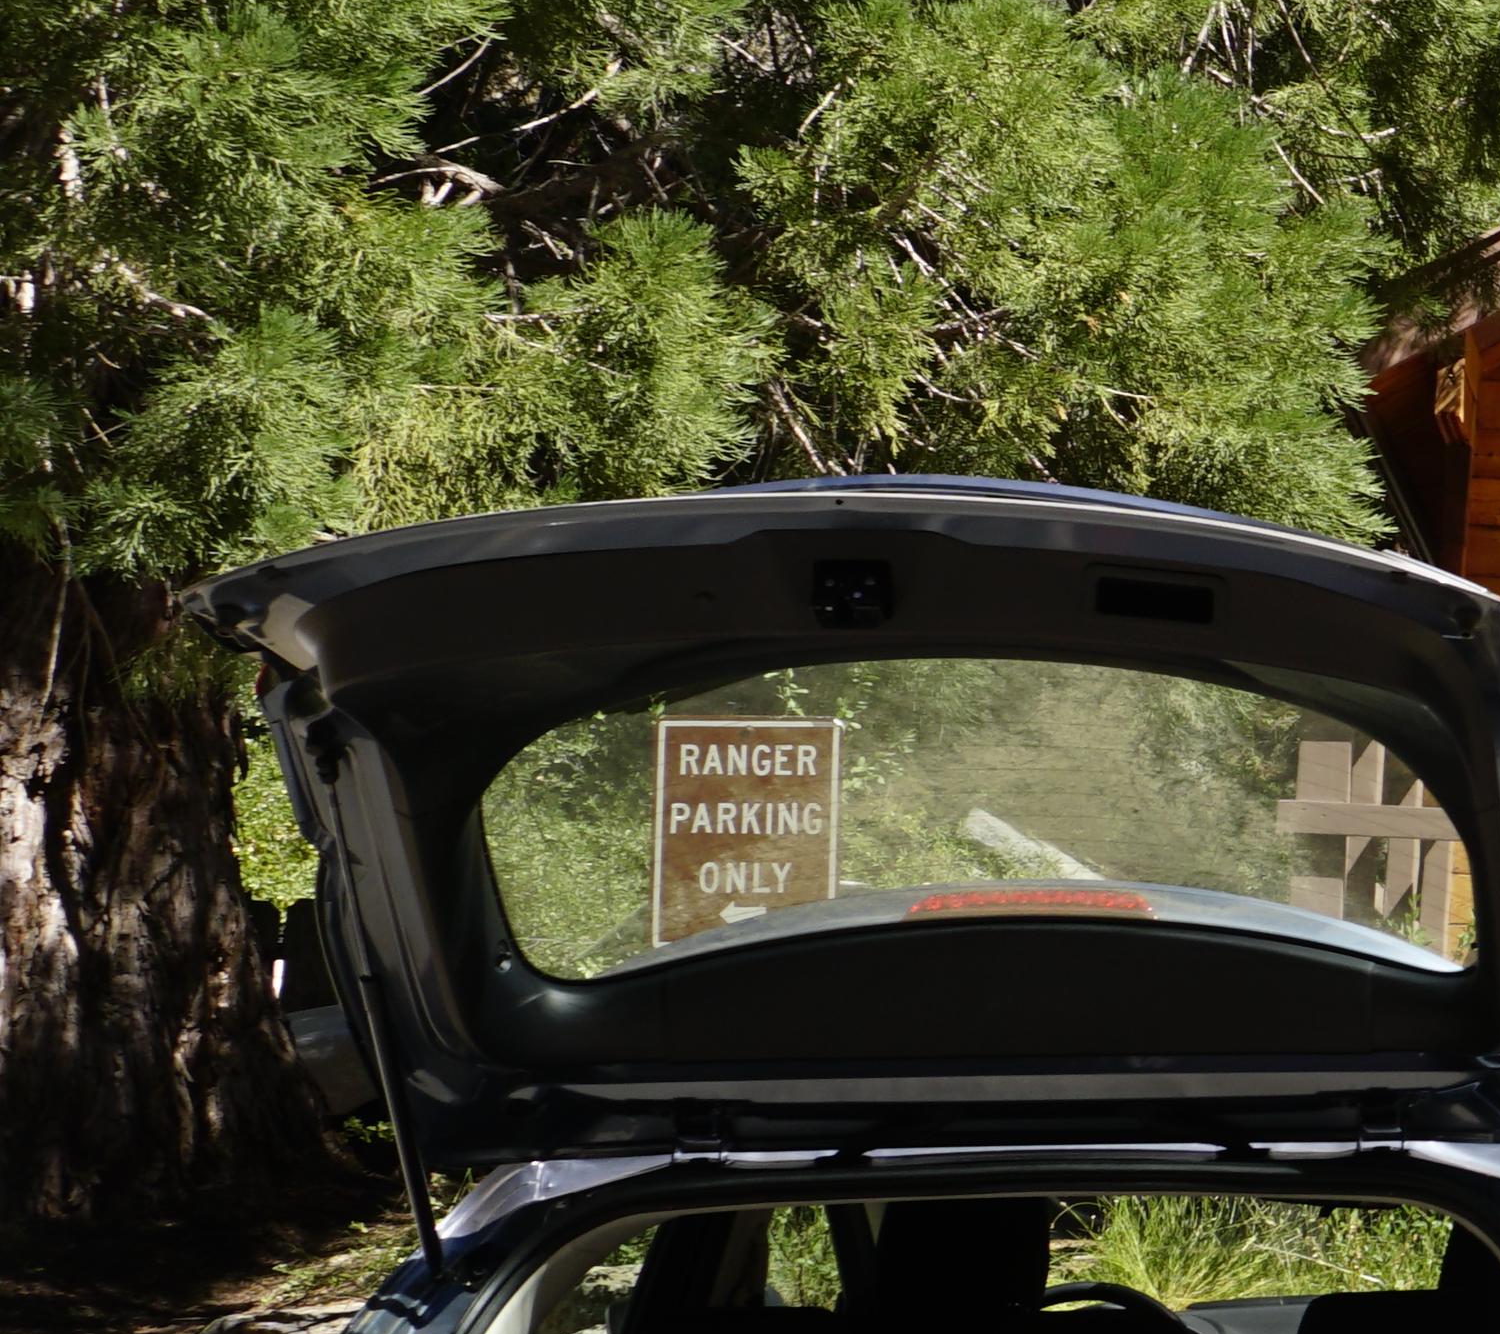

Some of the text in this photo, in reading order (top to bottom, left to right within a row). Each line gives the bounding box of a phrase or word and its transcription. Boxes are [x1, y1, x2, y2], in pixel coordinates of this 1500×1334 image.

[679, 743, 817, 777] RANGER
[669, 802, 823, 835] PARKING
[699, 861, 792, 894] ONLY
